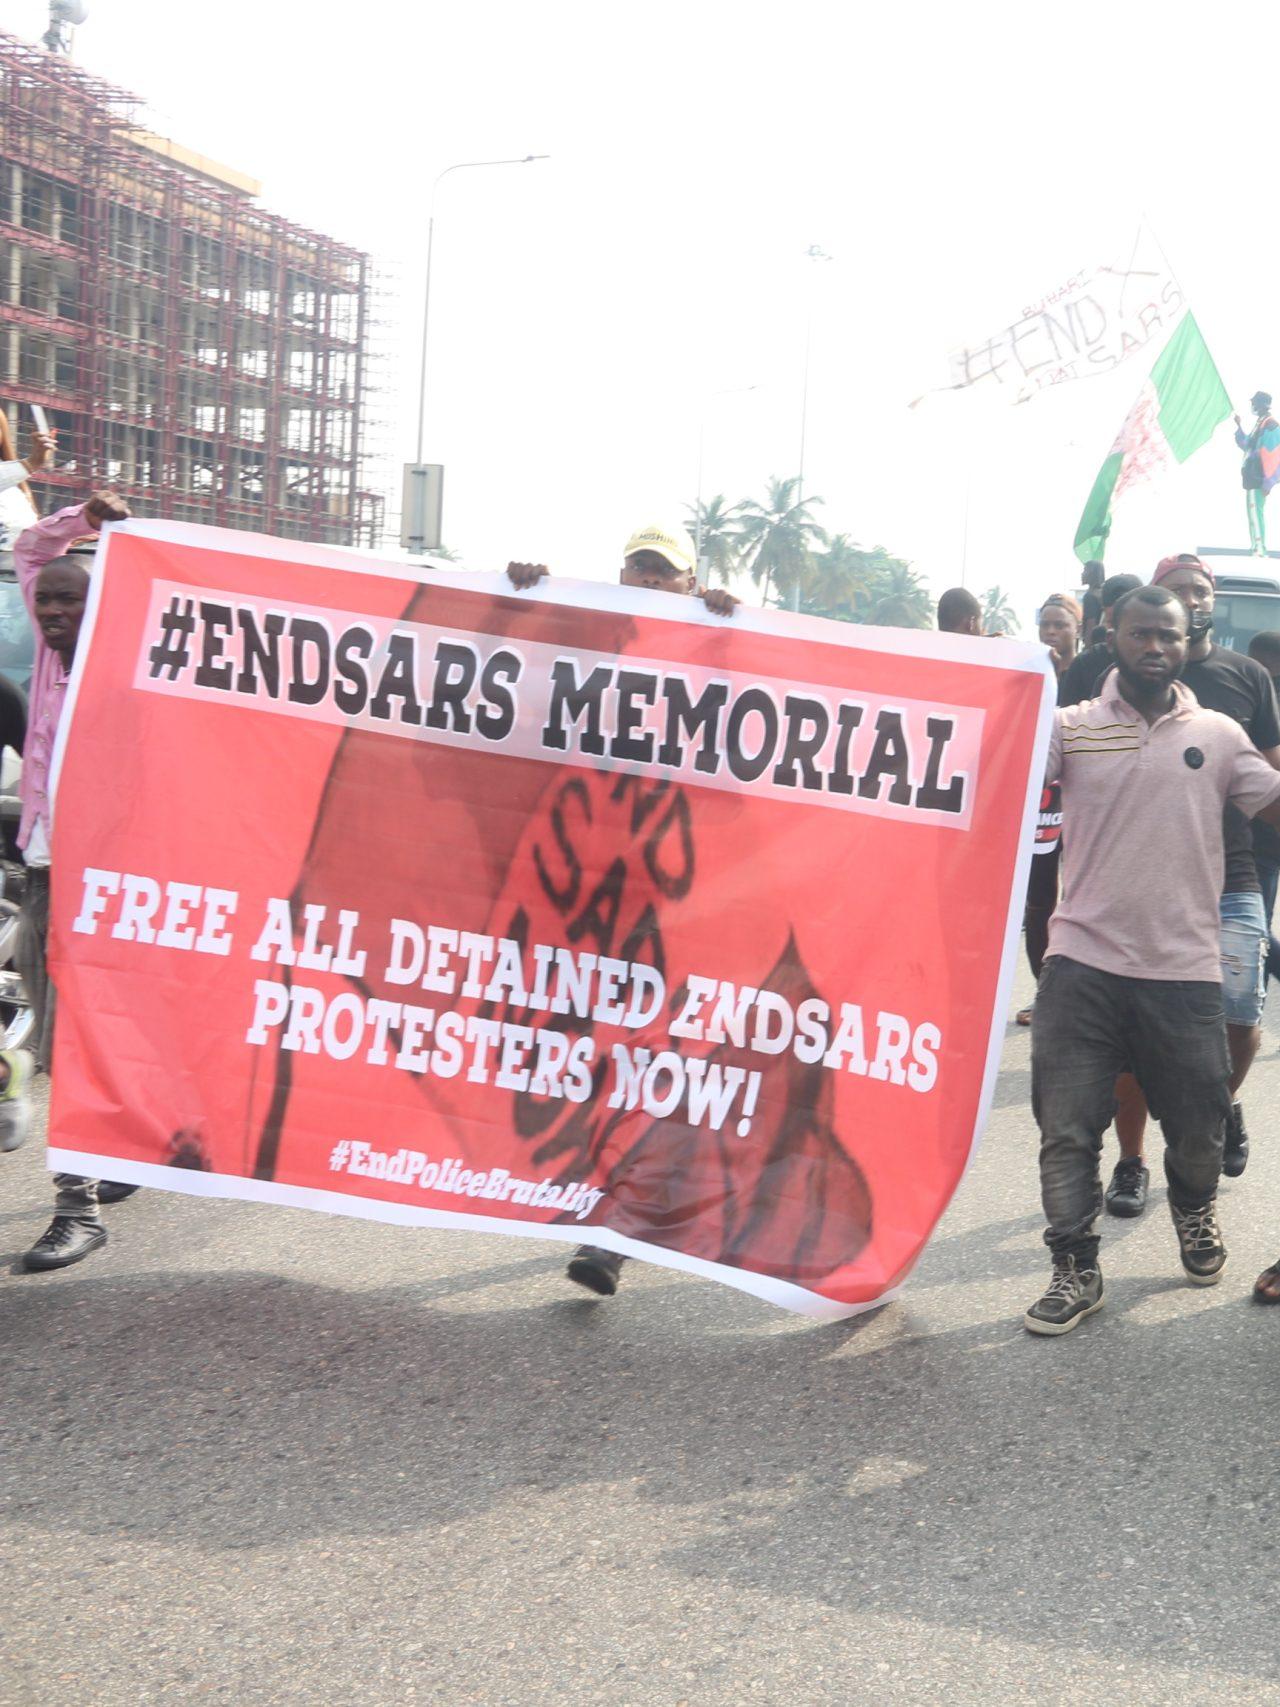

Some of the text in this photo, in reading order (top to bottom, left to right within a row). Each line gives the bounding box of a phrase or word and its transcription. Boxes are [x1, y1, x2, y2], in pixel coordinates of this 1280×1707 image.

[956, 294, 1107, 385] #END
[1088, 280, 1183, 365] SARS
[147, 594, 966, 814] #ENDSARS MEMORIAL
[72, 867, 942, 1093] FREE ALL DETAINED ENDSARS
[245, 979, 762, 1138] PROTESTERS NOW!
